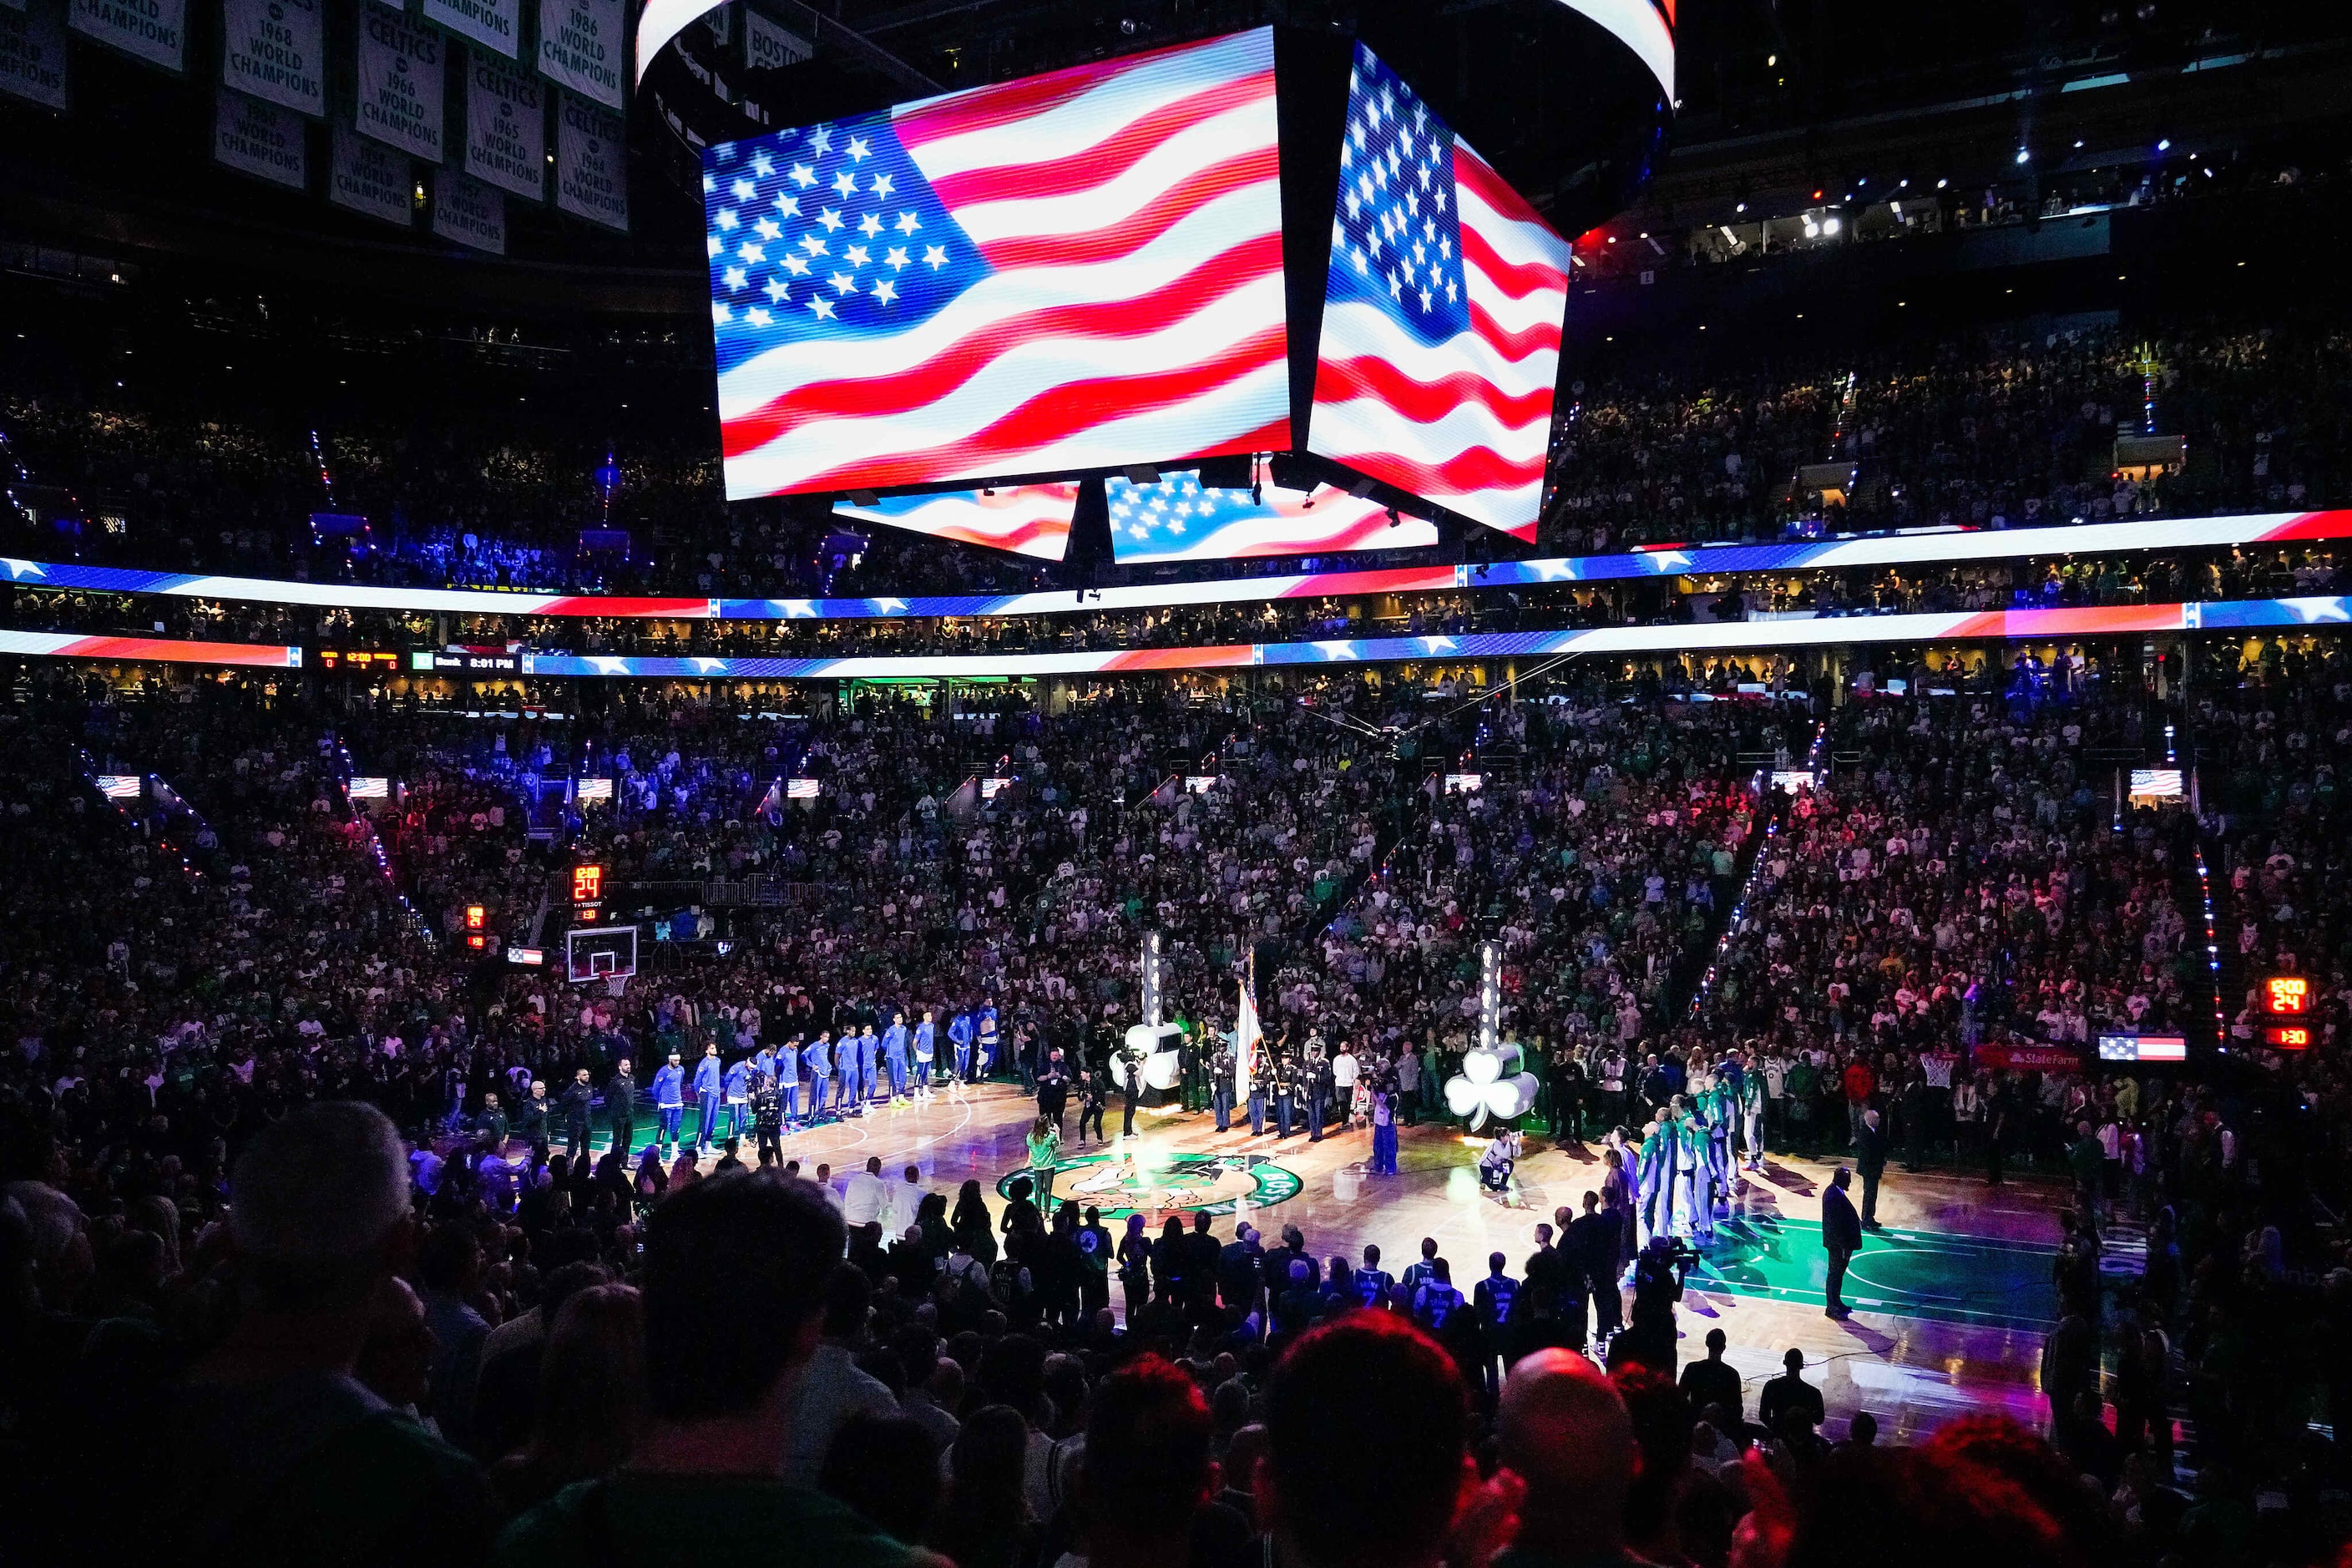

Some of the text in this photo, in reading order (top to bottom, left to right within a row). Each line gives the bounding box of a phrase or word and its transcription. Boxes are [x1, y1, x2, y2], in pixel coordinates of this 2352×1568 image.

[260, 20, 291, 46] 1968
[571, 9, 597, 36] 1986
[250, 38, 302, 70] WORLD
[369, 17, 436, 64] CELTICS
[560, 26, 604, 62] WORLD
[231, 53, 318, 97] CHAMPIONS
[544, 41, 616, 89] CHAMPIONS
[387, 72, 415, 97] 1966
[476, 67, 537, 109] CELTICS
[379, 88, 424, 119] WORLD
[237, 118, 286, 149] WORLD
[363, 102, 438, 146] CHAMPIONS
[493, 117, 519, 139] 1965
[222, 133, 300, 171] CHAMPIONS
[484, 132, 526, 161] WORLD
[352, 161, 394, 188] WORLD
[471, 145, 539, 185] CHAMPIONS
[583, 154, 604, 172] 1964
[337, 175, 407, 209] CHAMPIONS
[575, 168, 612, 195] WORLD
[563, 181, 625, 215] CHAMPIONS
[438, 209, 500, 240] CHAMPIONS
[326, 659, 333, 668] 0
[389, 661, 397, 670] 0
[436, 657, 462, 666] Bank
[470, 658, 493, 668] 8:01
[496, 659, 514, 669] PM
[575, 879, 597, 899] 24
[2273, 994, 2300, 1011] 24
[2282, 1029, 2306, 1044] 1:30
[2026, 1053, 2079, 1065] State Farm
[1362, 1291, 1377, 1310] 7
[1496, 1302, 1510, 1323] 7
[1432, 1308, 1446, 1328] 7
